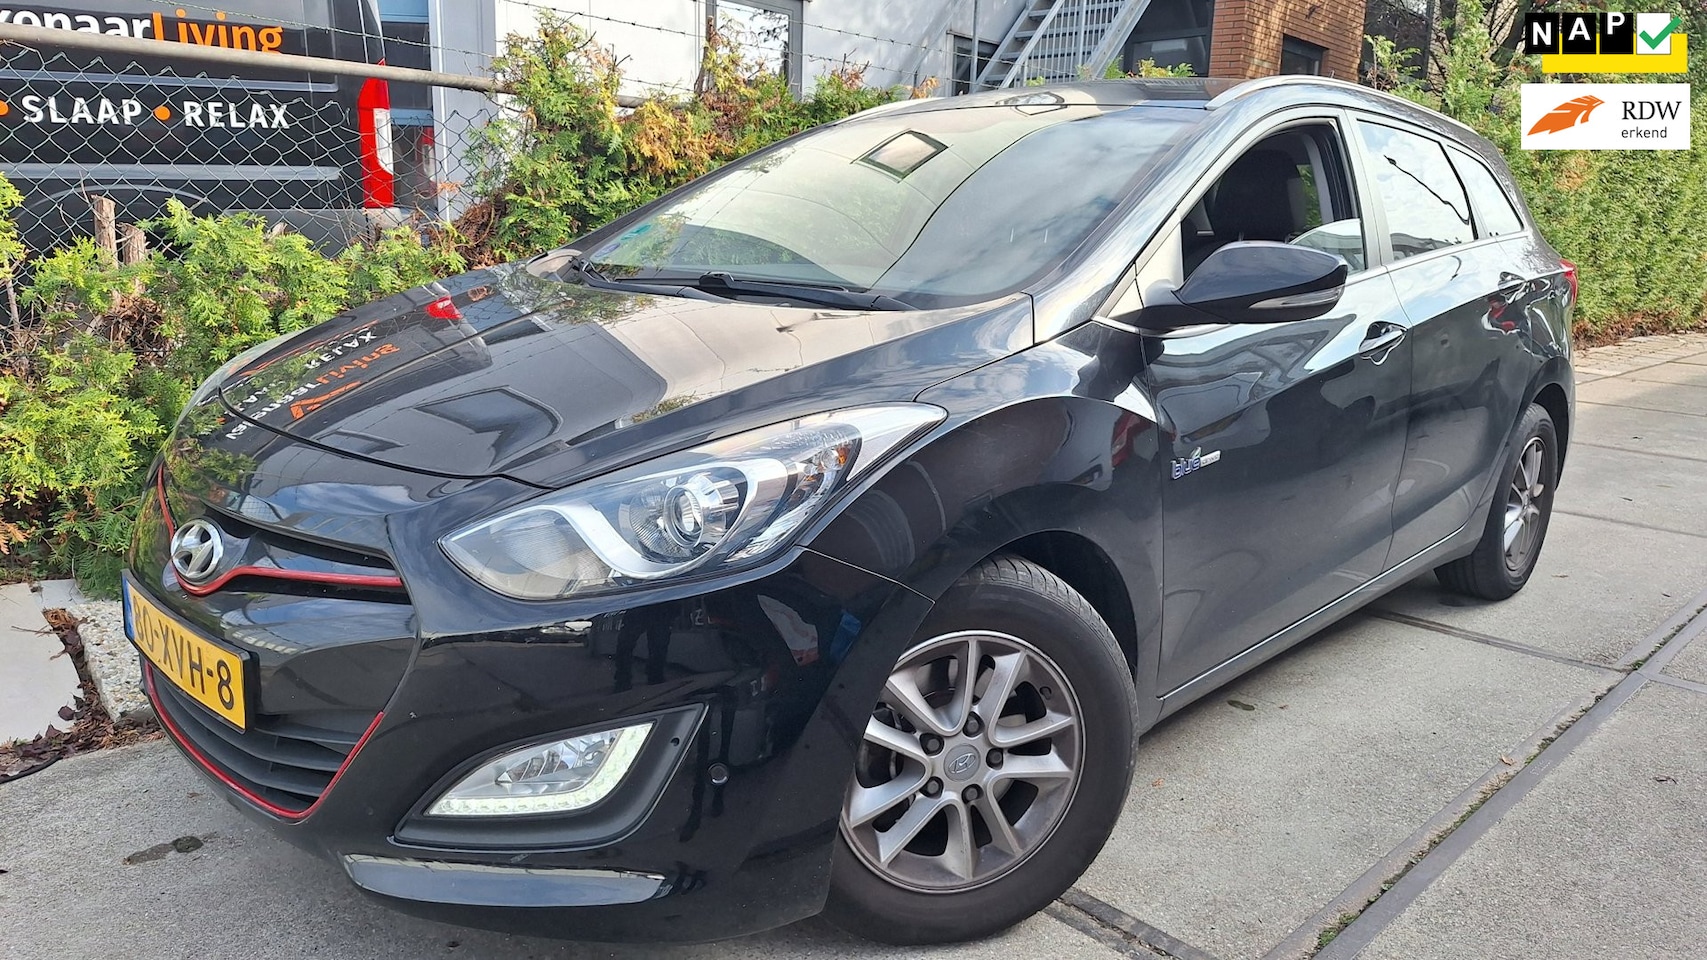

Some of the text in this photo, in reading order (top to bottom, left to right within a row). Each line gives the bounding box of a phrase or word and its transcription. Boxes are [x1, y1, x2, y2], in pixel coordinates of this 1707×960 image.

[21, 94, 291, 129] SLAAP RELAX
[1170, 456, 1201, 480] blue
[133, 595, 235, 711] 80-XVH-8
